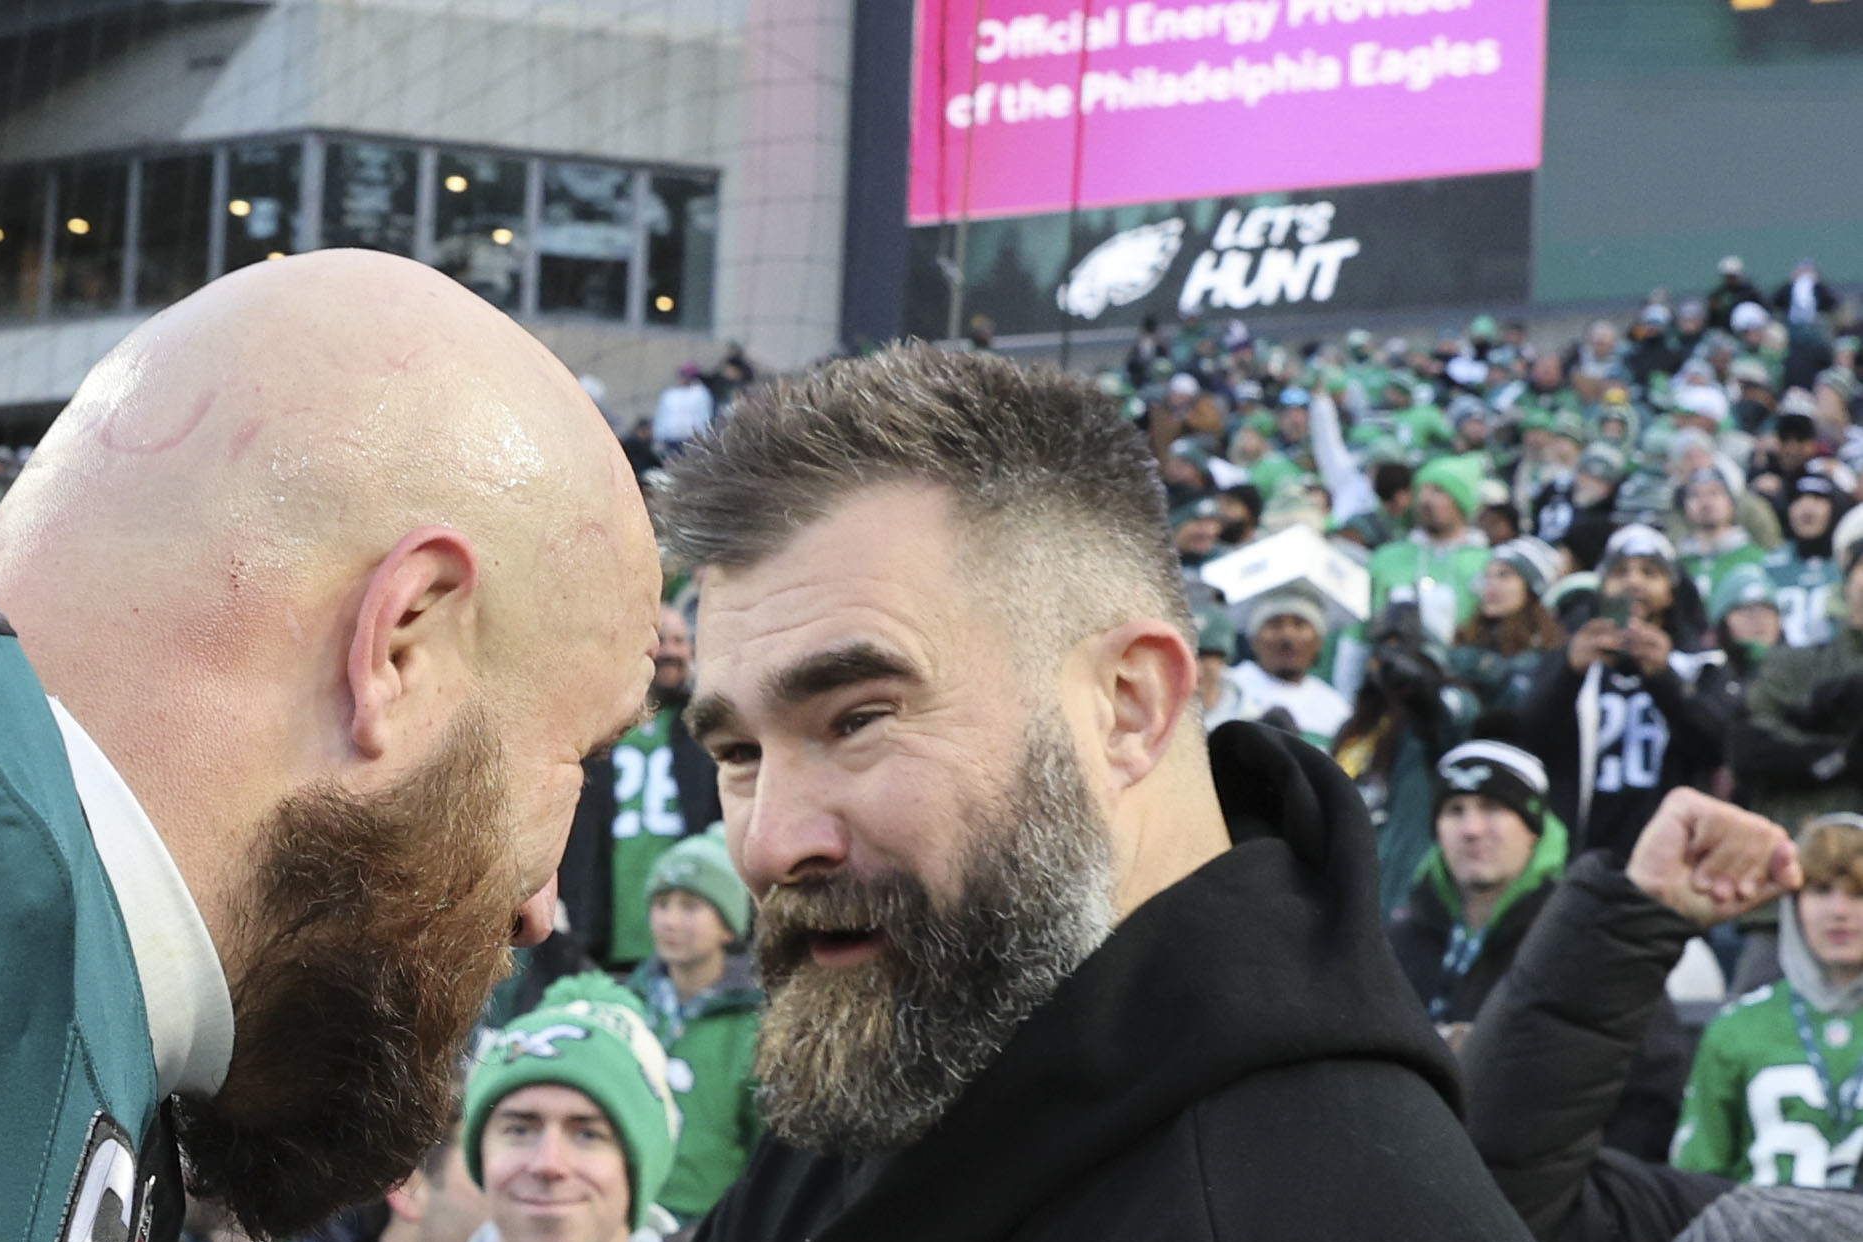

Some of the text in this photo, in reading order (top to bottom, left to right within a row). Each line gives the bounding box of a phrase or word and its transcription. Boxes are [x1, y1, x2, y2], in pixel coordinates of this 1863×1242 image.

[975, 12, 1119, 62] Official
[1126, 0, 1280, 45] Energy
[946, 36, 1503, 127] of the Philadelphia Eagles
[1213, 201, 1336, 249] LET'S
[1178, 238, 1361, 311] HUNT
